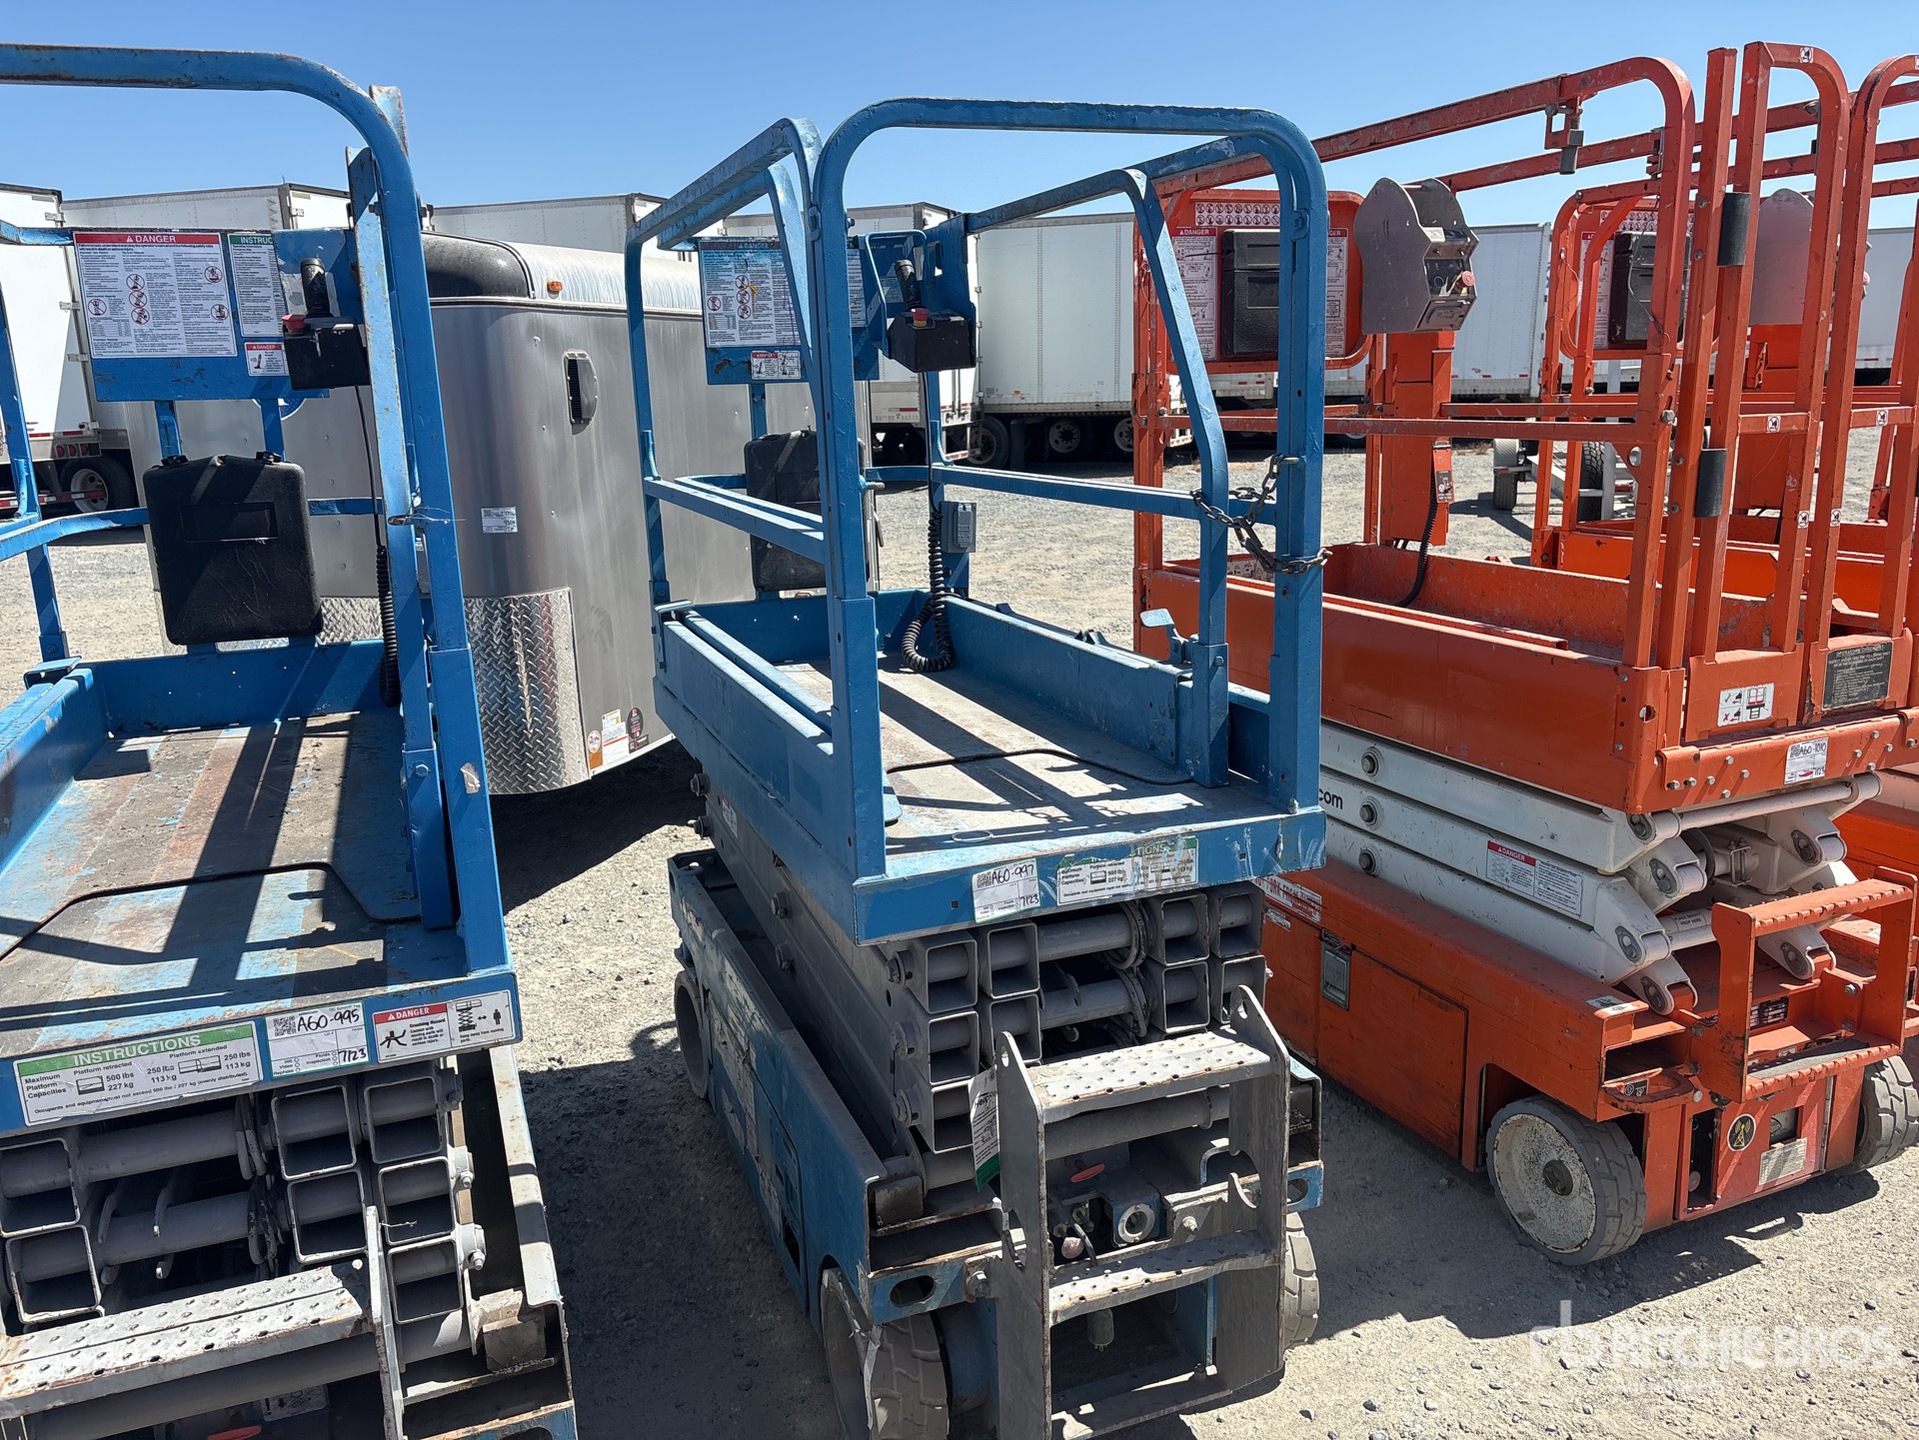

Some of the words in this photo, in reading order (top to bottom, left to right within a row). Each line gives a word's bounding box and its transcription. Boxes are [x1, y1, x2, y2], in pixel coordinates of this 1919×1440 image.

[135, 235, 176, 243] DANGER
[1501, 848, 1525, 862] DANGER
[396, 1007, 430, 1019] DANGER
[297, 1008, 360, 1032] A60-995
[74, 1034, 201, 1066] INSTRUCTIONS
[169, 1050, 197, 1059] Platform
[198, 1045, 228, 1054] extended
[224, 1053, 238, 1061] 250
[239, 1051, 251, 1059] lbs
[73, 1066, 102, 1076] Platform
[103, 1061, 133, 1071] retracted
[225, 1062, 240, 1070] 113
[241, 1061, 251, 1069] kg
[147, 1067, 161, 1075] 250
[25, 1073, 61, 1084] Maximum
[106, 1074, 121, 1082] 500
[122, 1072, 135, 1080] lbs
[166, 1074, 177, 1082] kg
[26, 1082, 58, 1092] Platform
[124, 1081, 134, 1090] kg
[28, 1087, 67, 1099] Capacities
[35, 1105, 64, 1114] Occupants
